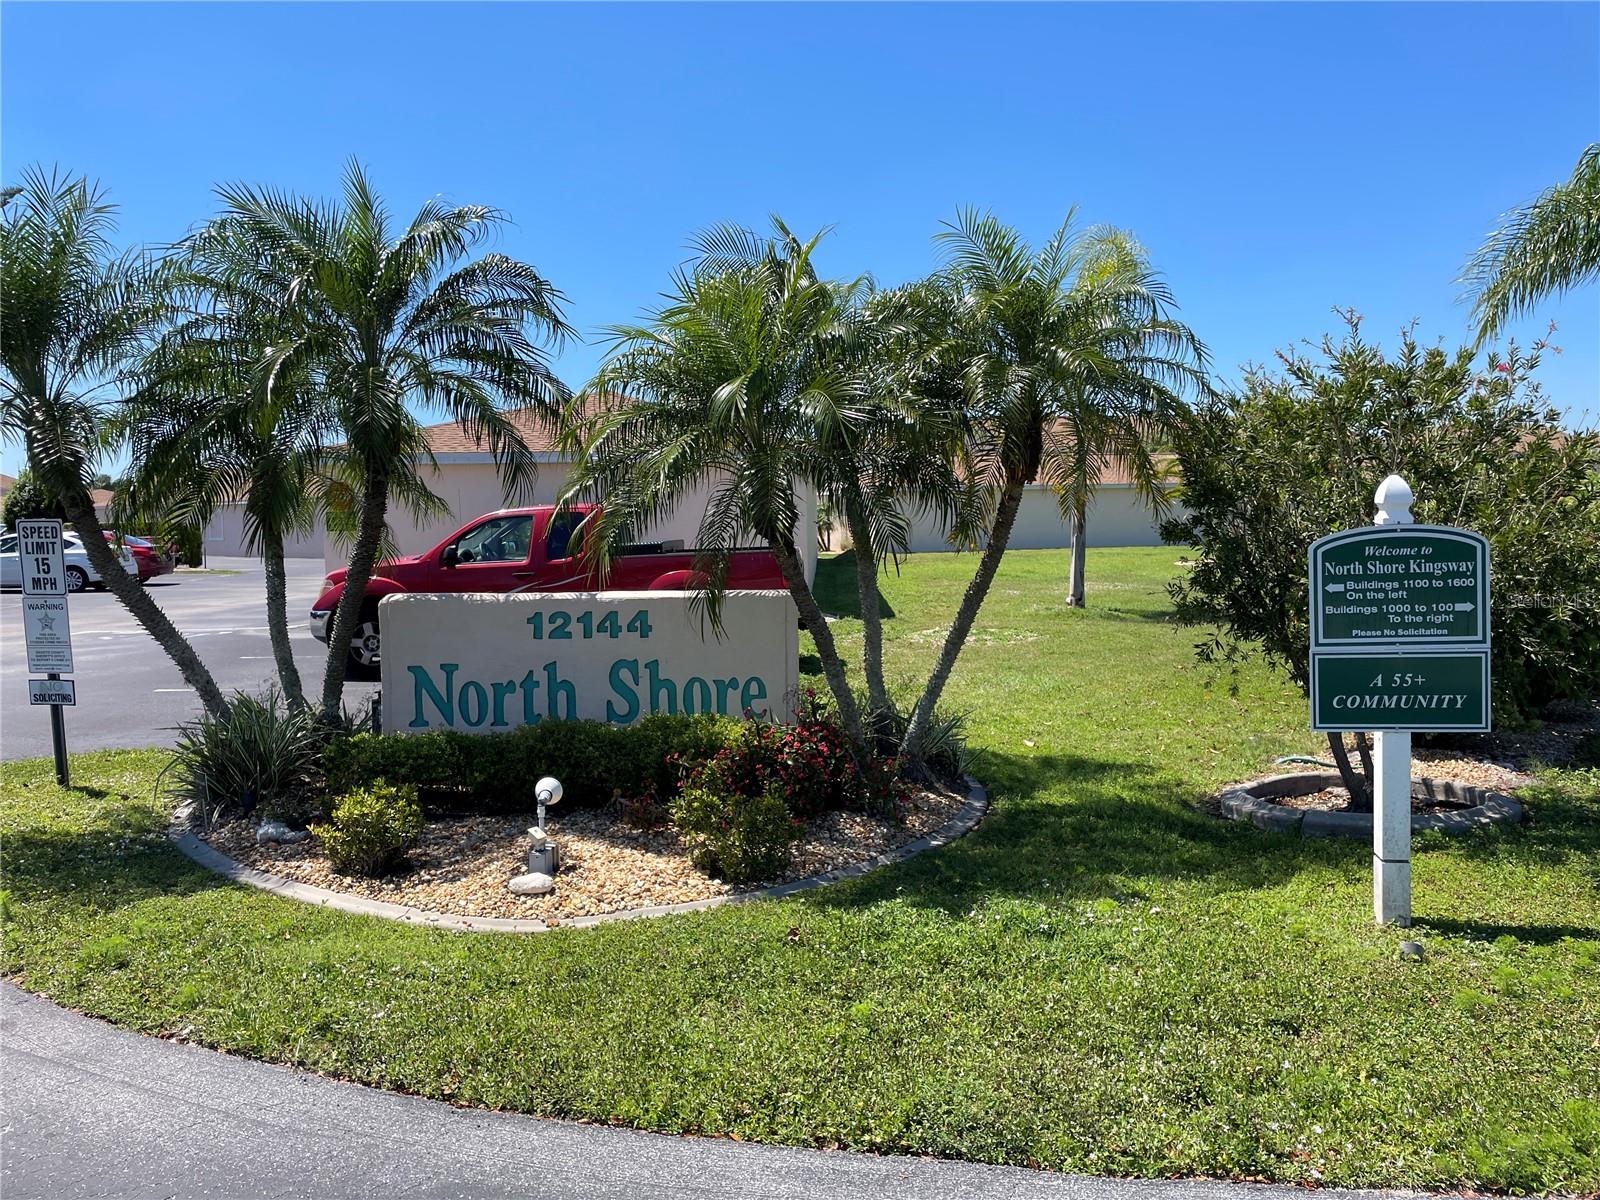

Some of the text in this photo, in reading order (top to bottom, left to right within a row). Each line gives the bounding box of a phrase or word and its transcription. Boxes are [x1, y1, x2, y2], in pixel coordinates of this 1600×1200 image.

[22, 526, 58, 539] SPEED
[25, 541, 57, 555] LIMIT
[1364, 546, 1433, 557] Welcome to
[34, 557, 51, 575] 15
[1324, 559, 1475, 576] North Shore Kingsway
[31, 577, 57, 590] MPH
[1346, 578, 1475, 591] Buildings 1100 to 1600
[1346, 590, 1408, 600] On the left
[27, 603, 64, 611] WARNING
[1325, 603, 1454, 615] Buildings 1000 to 100
[526, 609, 653, 640] 12144
[1387, 613, 1454, 624] To the right
[1352, 629, 1382, 637] Please
[1397, 627, 1448, 636] Solicitation
[39, 681, 63, 692] NO
[1369, 673, 1426, 687] A 55+
[33, 693, 73, 703] SOLICITING
[407, 658, 768, 728] North Shore
[1332, 694, 1468, 709] COMMUNITY
